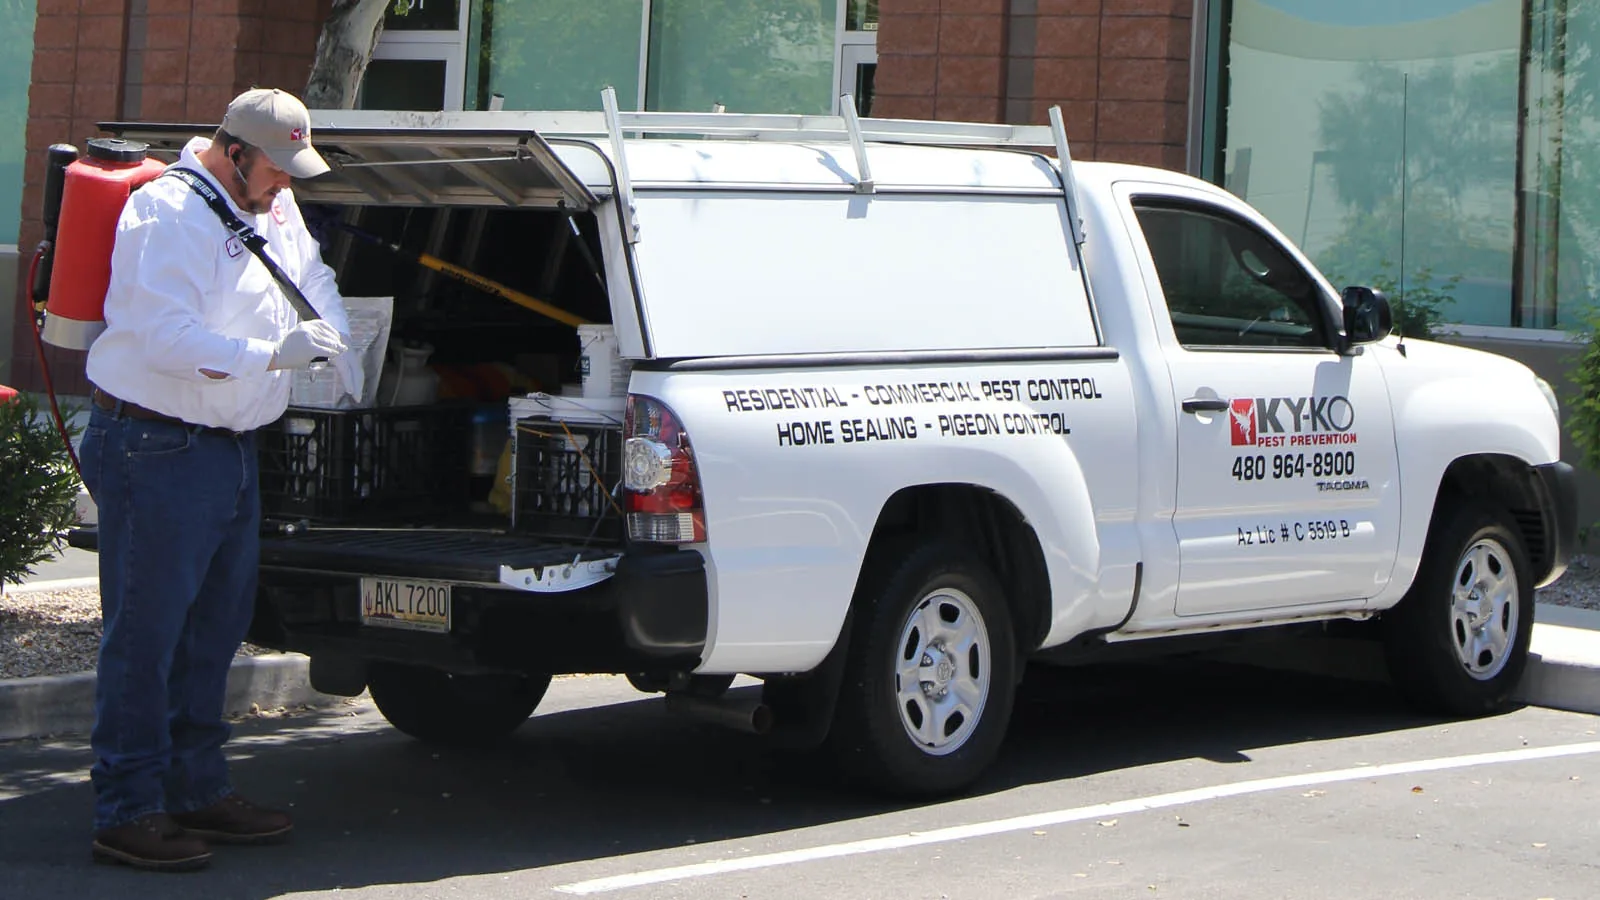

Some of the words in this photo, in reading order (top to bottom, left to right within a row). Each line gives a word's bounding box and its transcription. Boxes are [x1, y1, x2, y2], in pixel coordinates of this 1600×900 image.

[722, 386, 848, 412] RESIDENTIAL
[863, 381, 979, 405] COMMERCIAL
[981, 380, 1020, 401] PEST
[1027, 377, 1102, 401] CONTROL
[776, 419, 835, 447] HOME
[840, 416, 917, 443] SEALING
[937, 413, 1000, 437] PIGEON
[1002, 412, 1071, 435] CONTROL
[1256, 395, 1354, 433] KY-KO
[1258, 436, 1285, 447] PEST
[1290, 433, 1357, 446] PREVENTION
[1232, 455, 1266, 480] 480
[1272, 451, 1355, 479] 964-8900
[1316, 480, 1370, 491] TACOMA
[1237, 527, 1253, 546] Az
[1257, 525, 1276, 544] Lic
[1281, 523, 1290, 542] #
[1294, 522, 1305, 541] C
[1308, 520, 1337, 540] 5519
[1340, 519, 1350, 537] B
[375, 581, 447, 616] AKL7200
